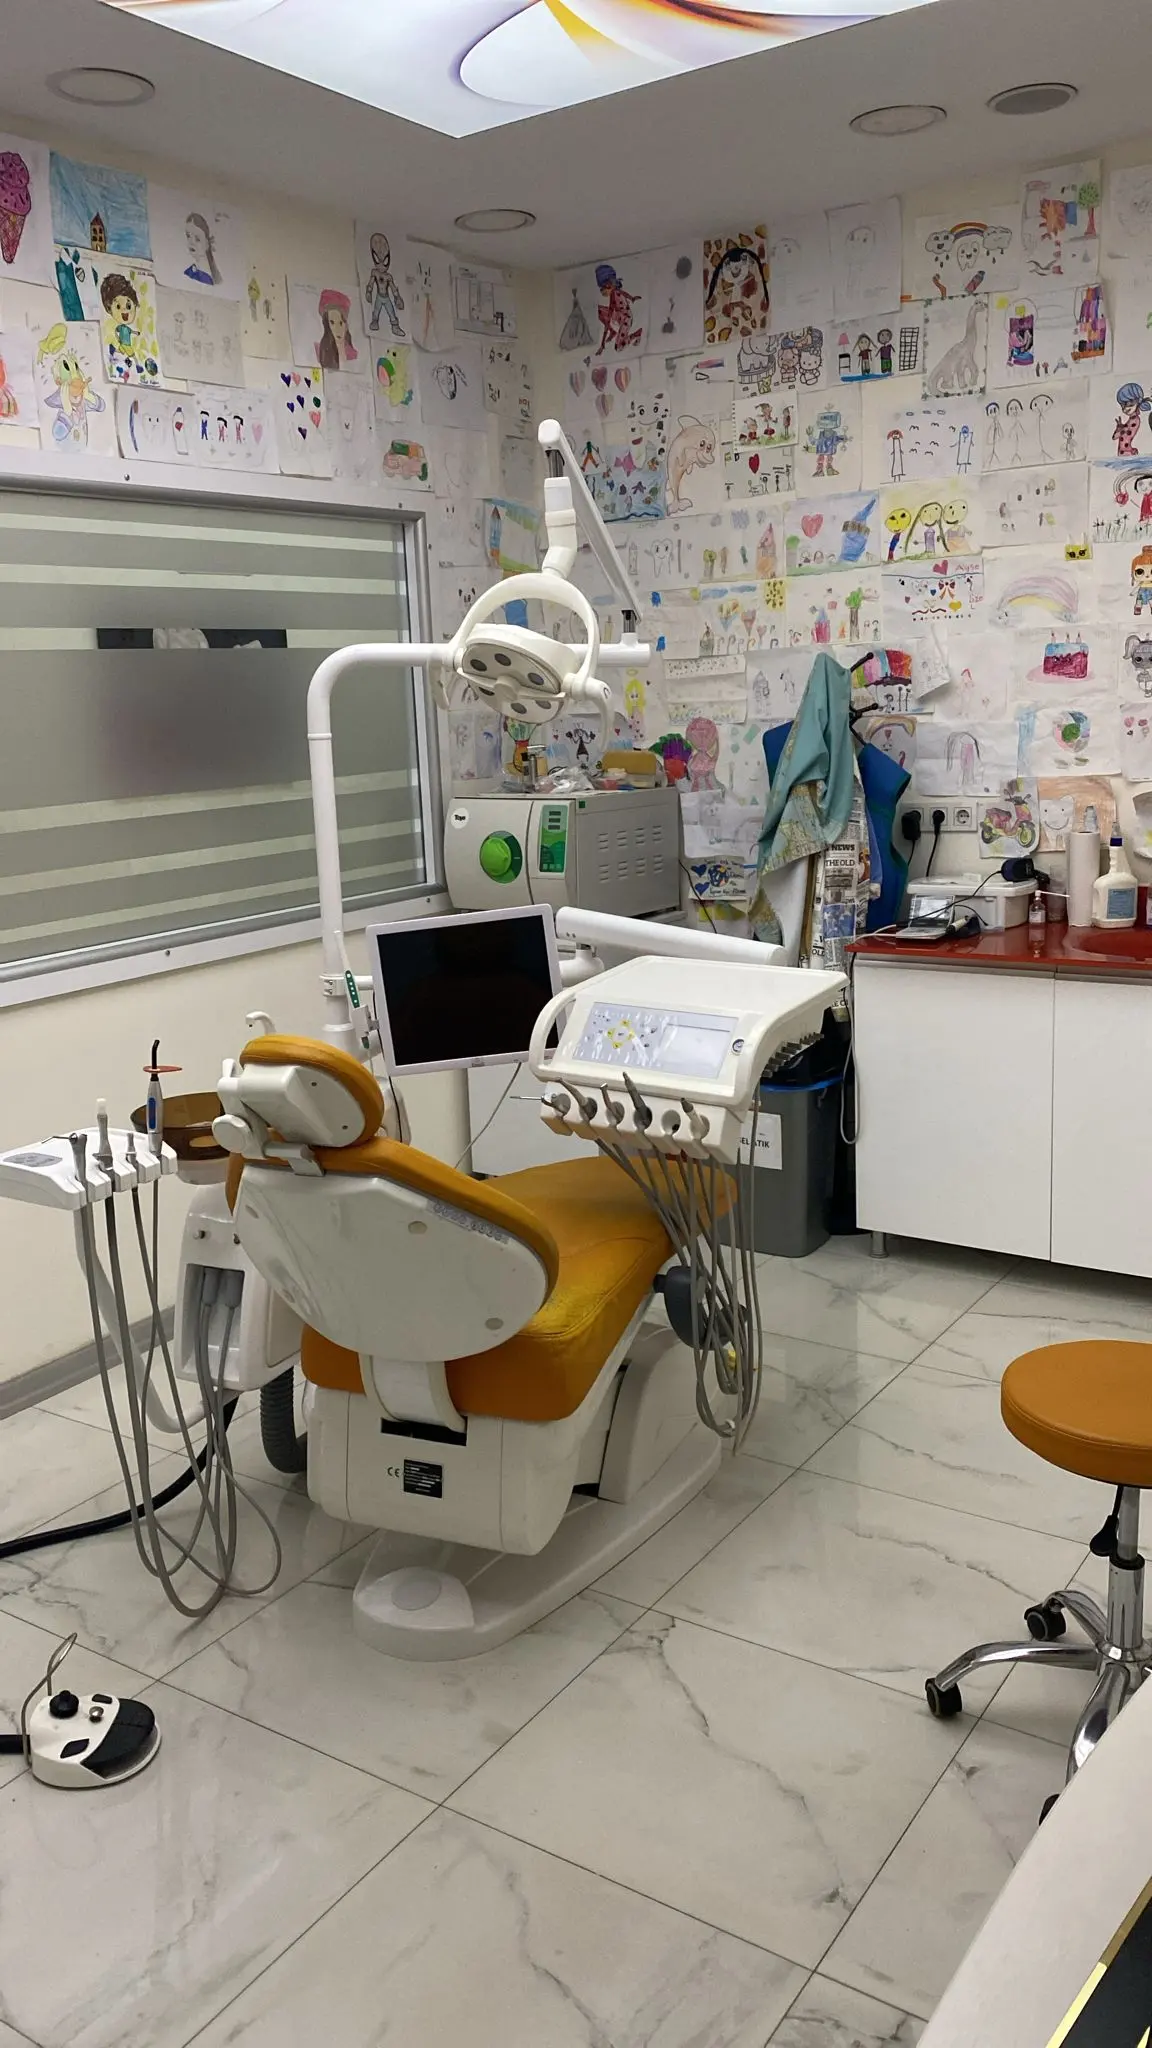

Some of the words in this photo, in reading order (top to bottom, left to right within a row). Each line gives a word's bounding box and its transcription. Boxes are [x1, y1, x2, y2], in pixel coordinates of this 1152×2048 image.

[831, 844, 855, 852] NEWS
[825, 859, 839, 867] THE
[839, 859, 855, 867] OLD
